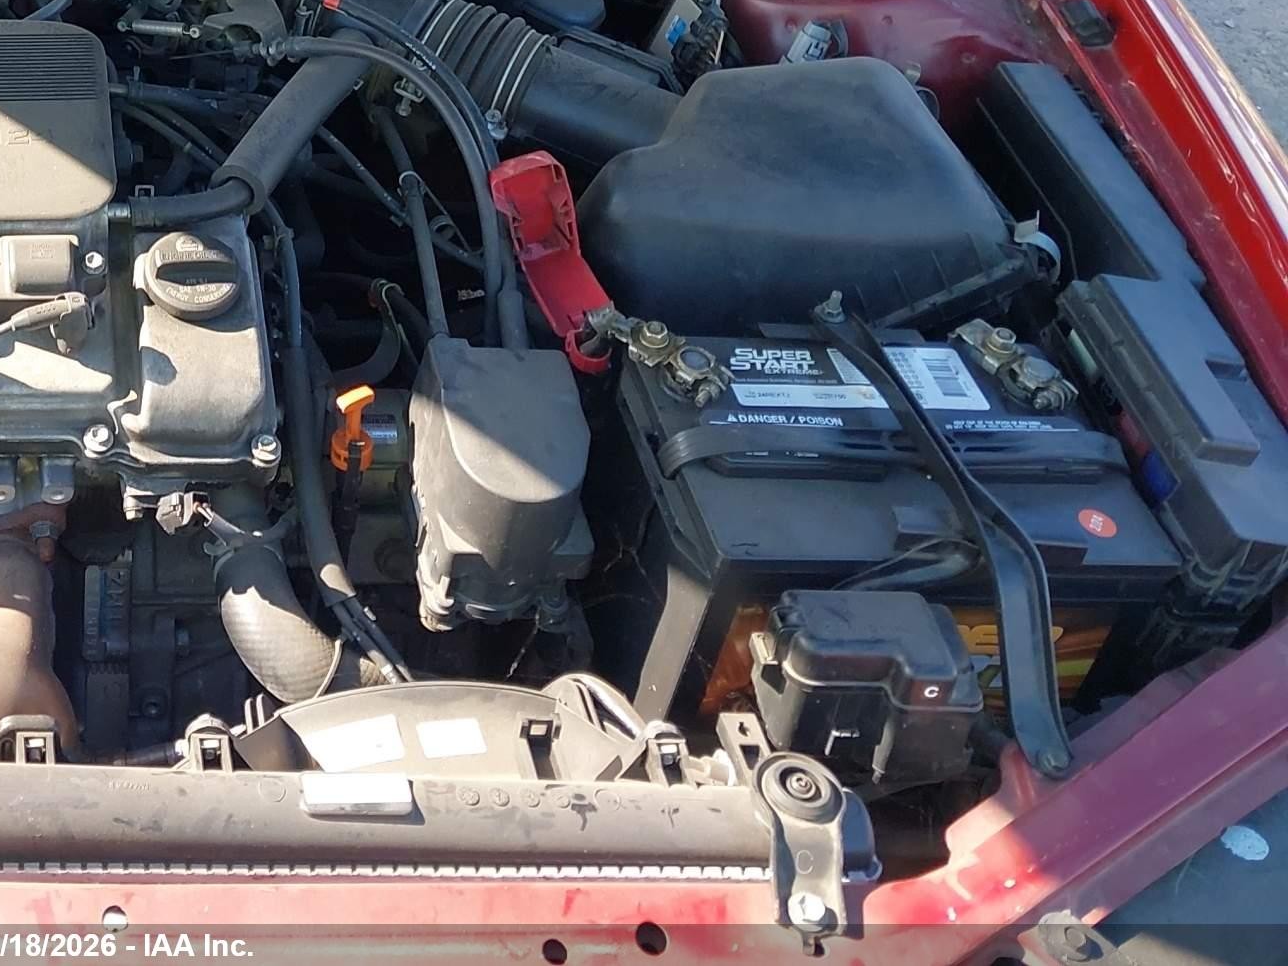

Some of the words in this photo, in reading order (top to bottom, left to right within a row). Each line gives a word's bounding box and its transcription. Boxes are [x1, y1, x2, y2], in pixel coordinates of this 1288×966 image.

[735, 347, 812, 361] SUPER
[730, 357, 816, 371] START
[738, 412, 788, 424] DANGER
[798, 415, 844, 427] POISON
